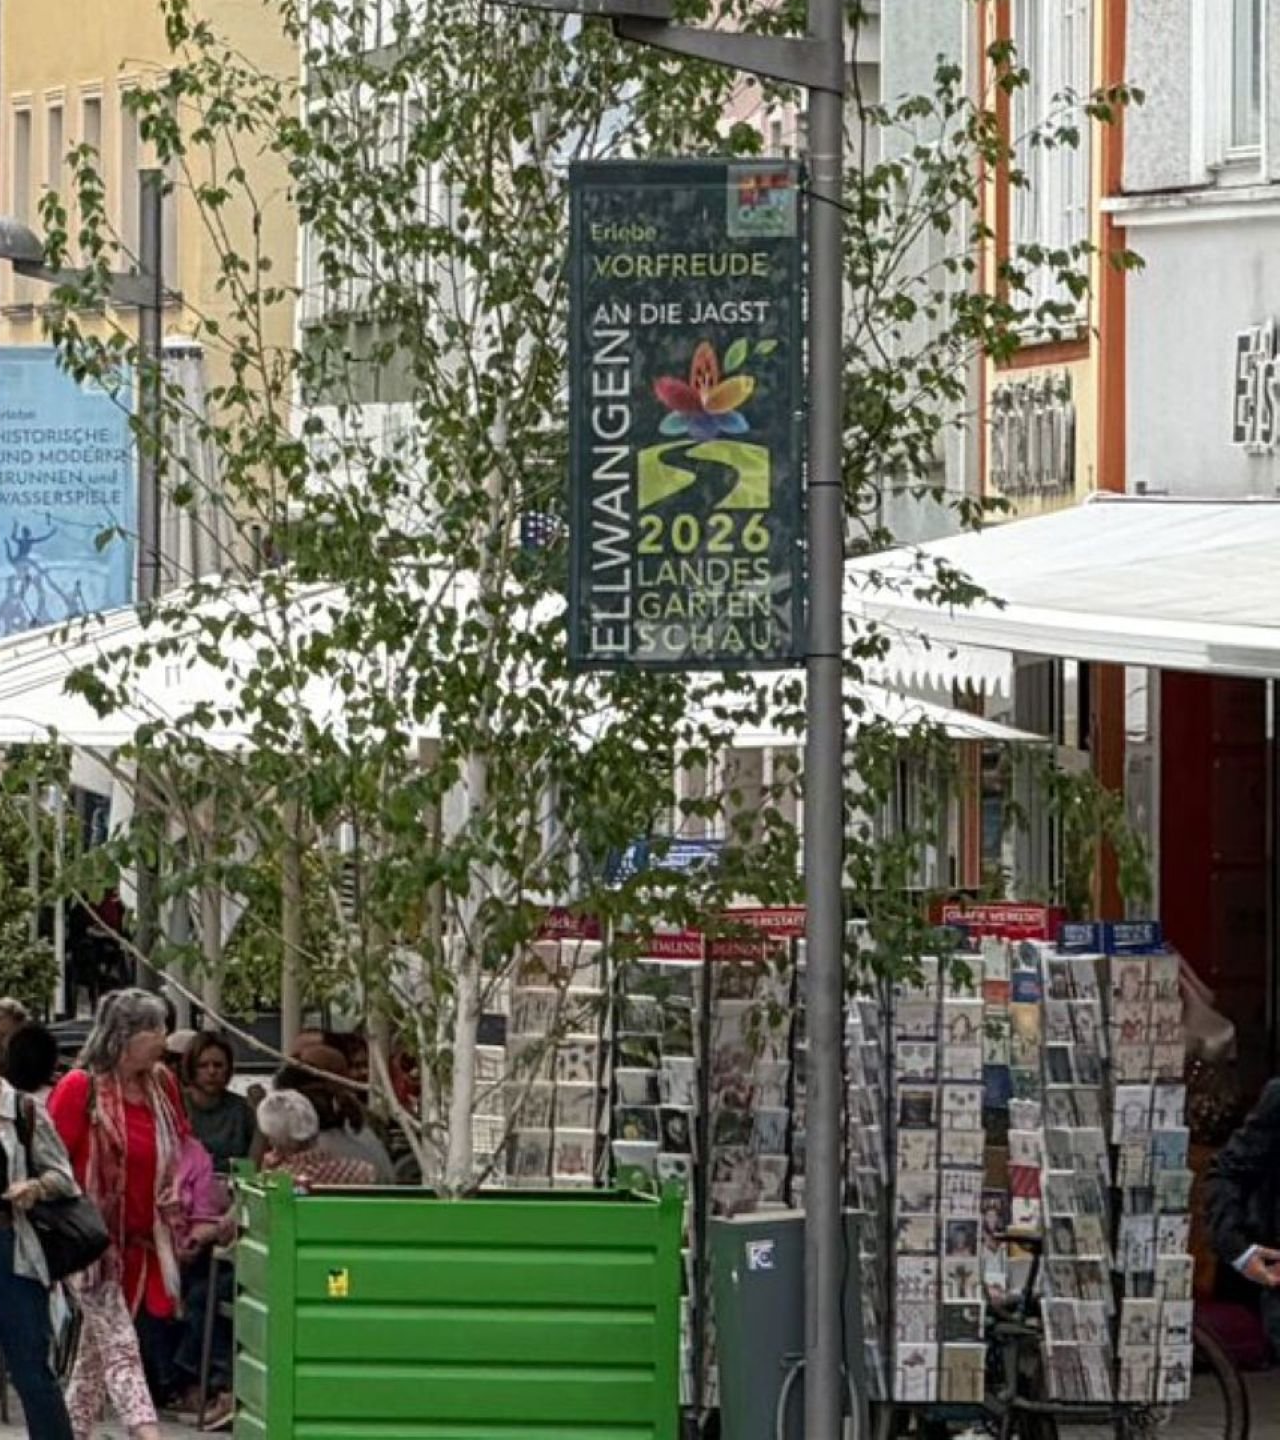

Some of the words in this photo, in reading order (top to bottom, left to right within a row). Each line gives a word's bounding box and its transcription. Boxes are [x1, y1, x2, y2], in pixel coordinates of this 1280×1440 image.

[591, 223, 657, 242] Erlebe
[593, 252, 769, 278] VORFREUDE
[593, 303, 631, 325] AN
[639, 303, 683, 325] DIE
[689, 300, 771, 324] JAGST
[591, 327, 632, 654] ELLWANGEN
[637, 514, 772, 555] 2026
[638, 557, 771, 588] LANDES
[638, 590, 772, 621] GARTEN
[639, 622, 774, 652] SCHAU
